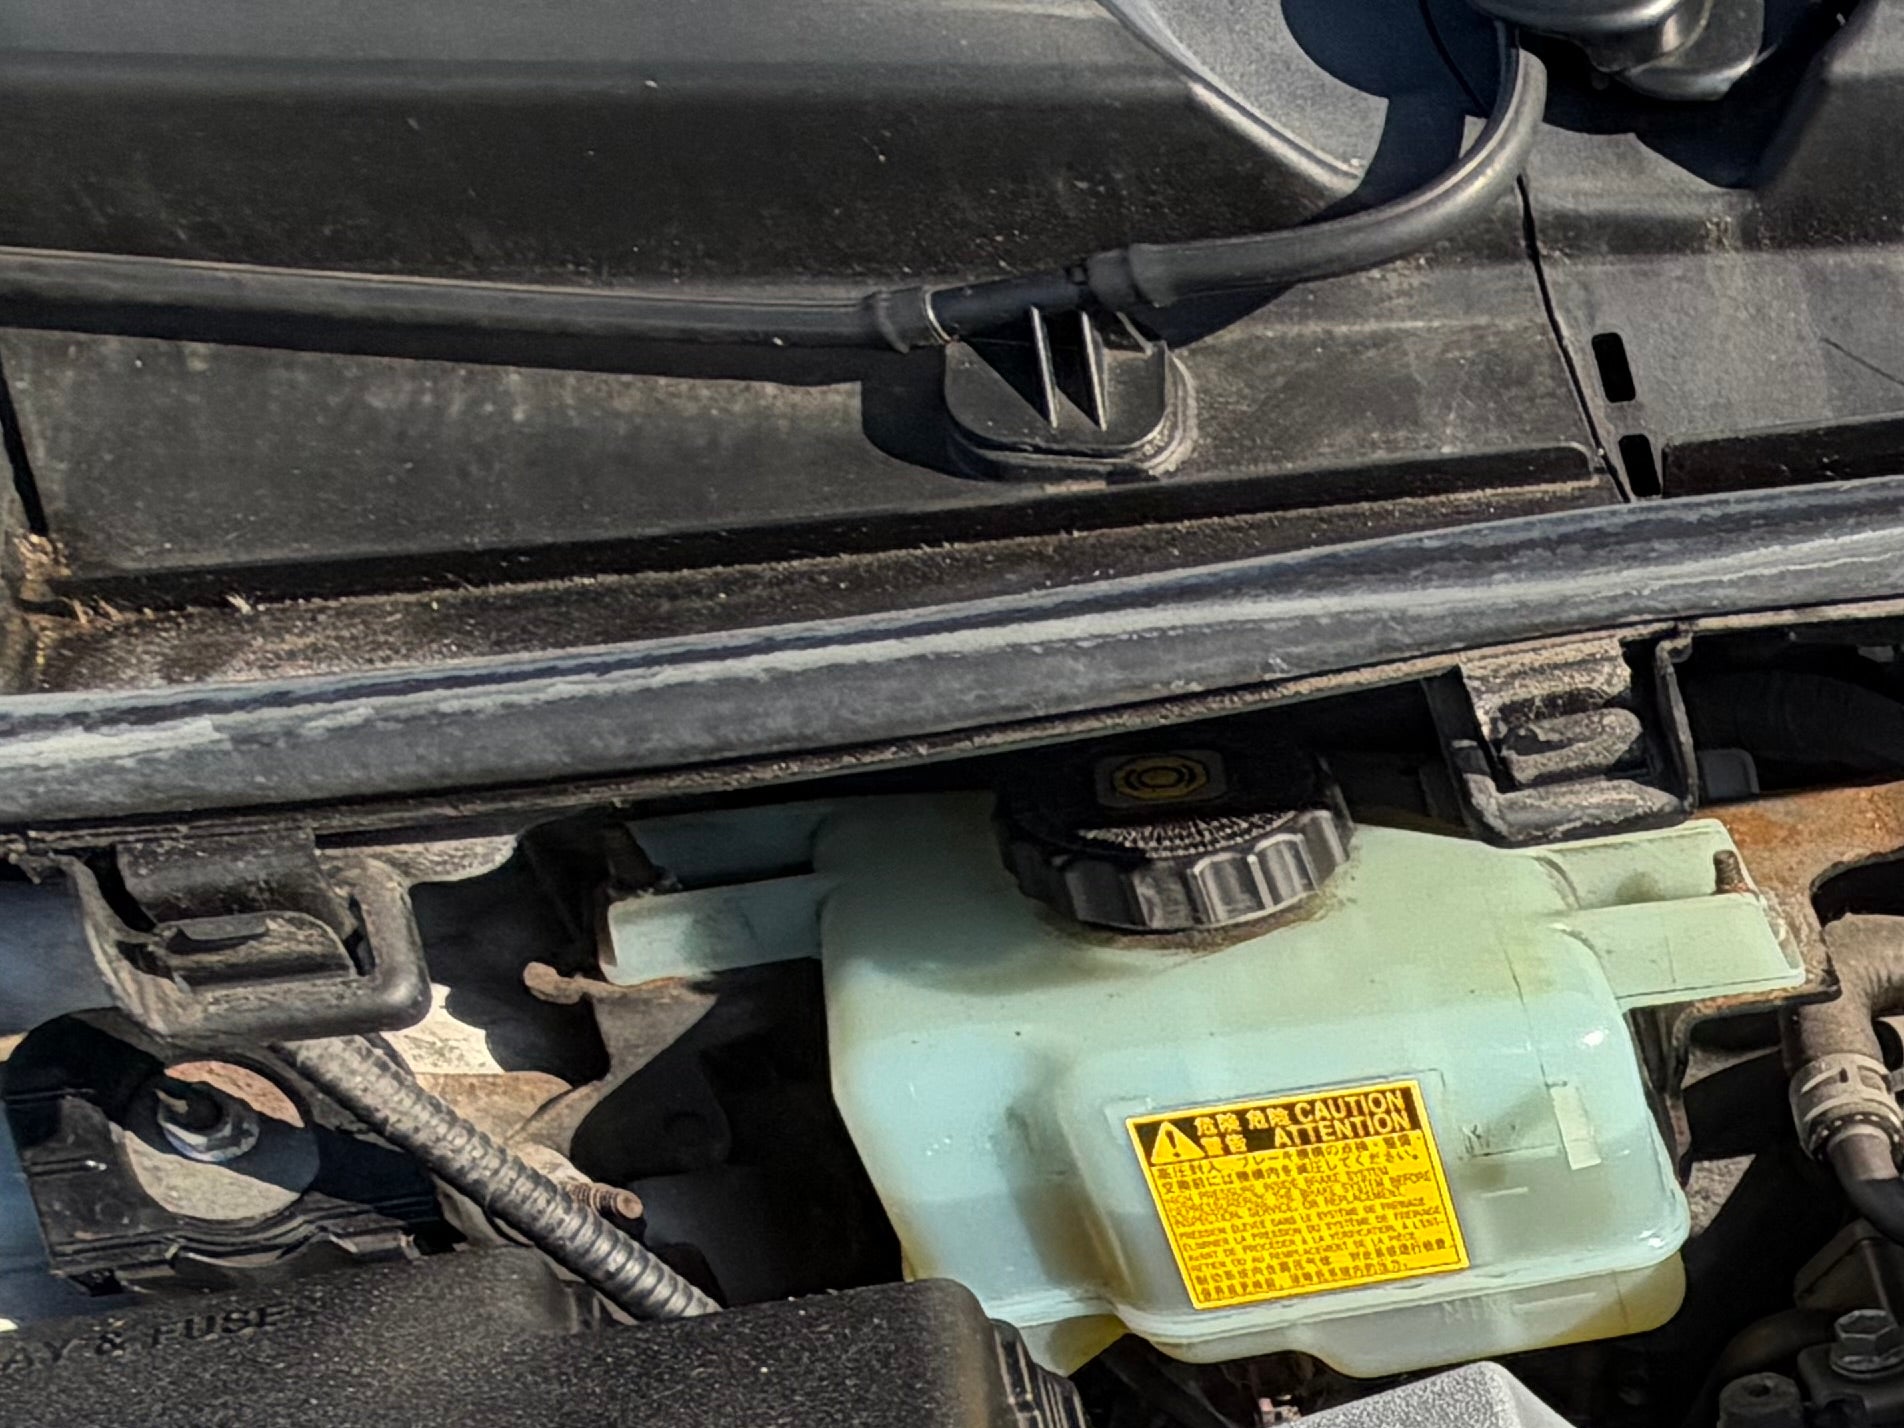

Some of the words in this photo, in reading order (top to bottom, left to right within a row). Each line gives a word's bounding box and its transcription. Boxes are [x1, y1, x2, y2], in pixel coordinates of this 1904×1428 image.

[1292, 1089, 1405, 1123] CAUTION
[1270, 1110, 1411, 1147] ATTENTION
[151, 1304, 298, 1349] FUSE
